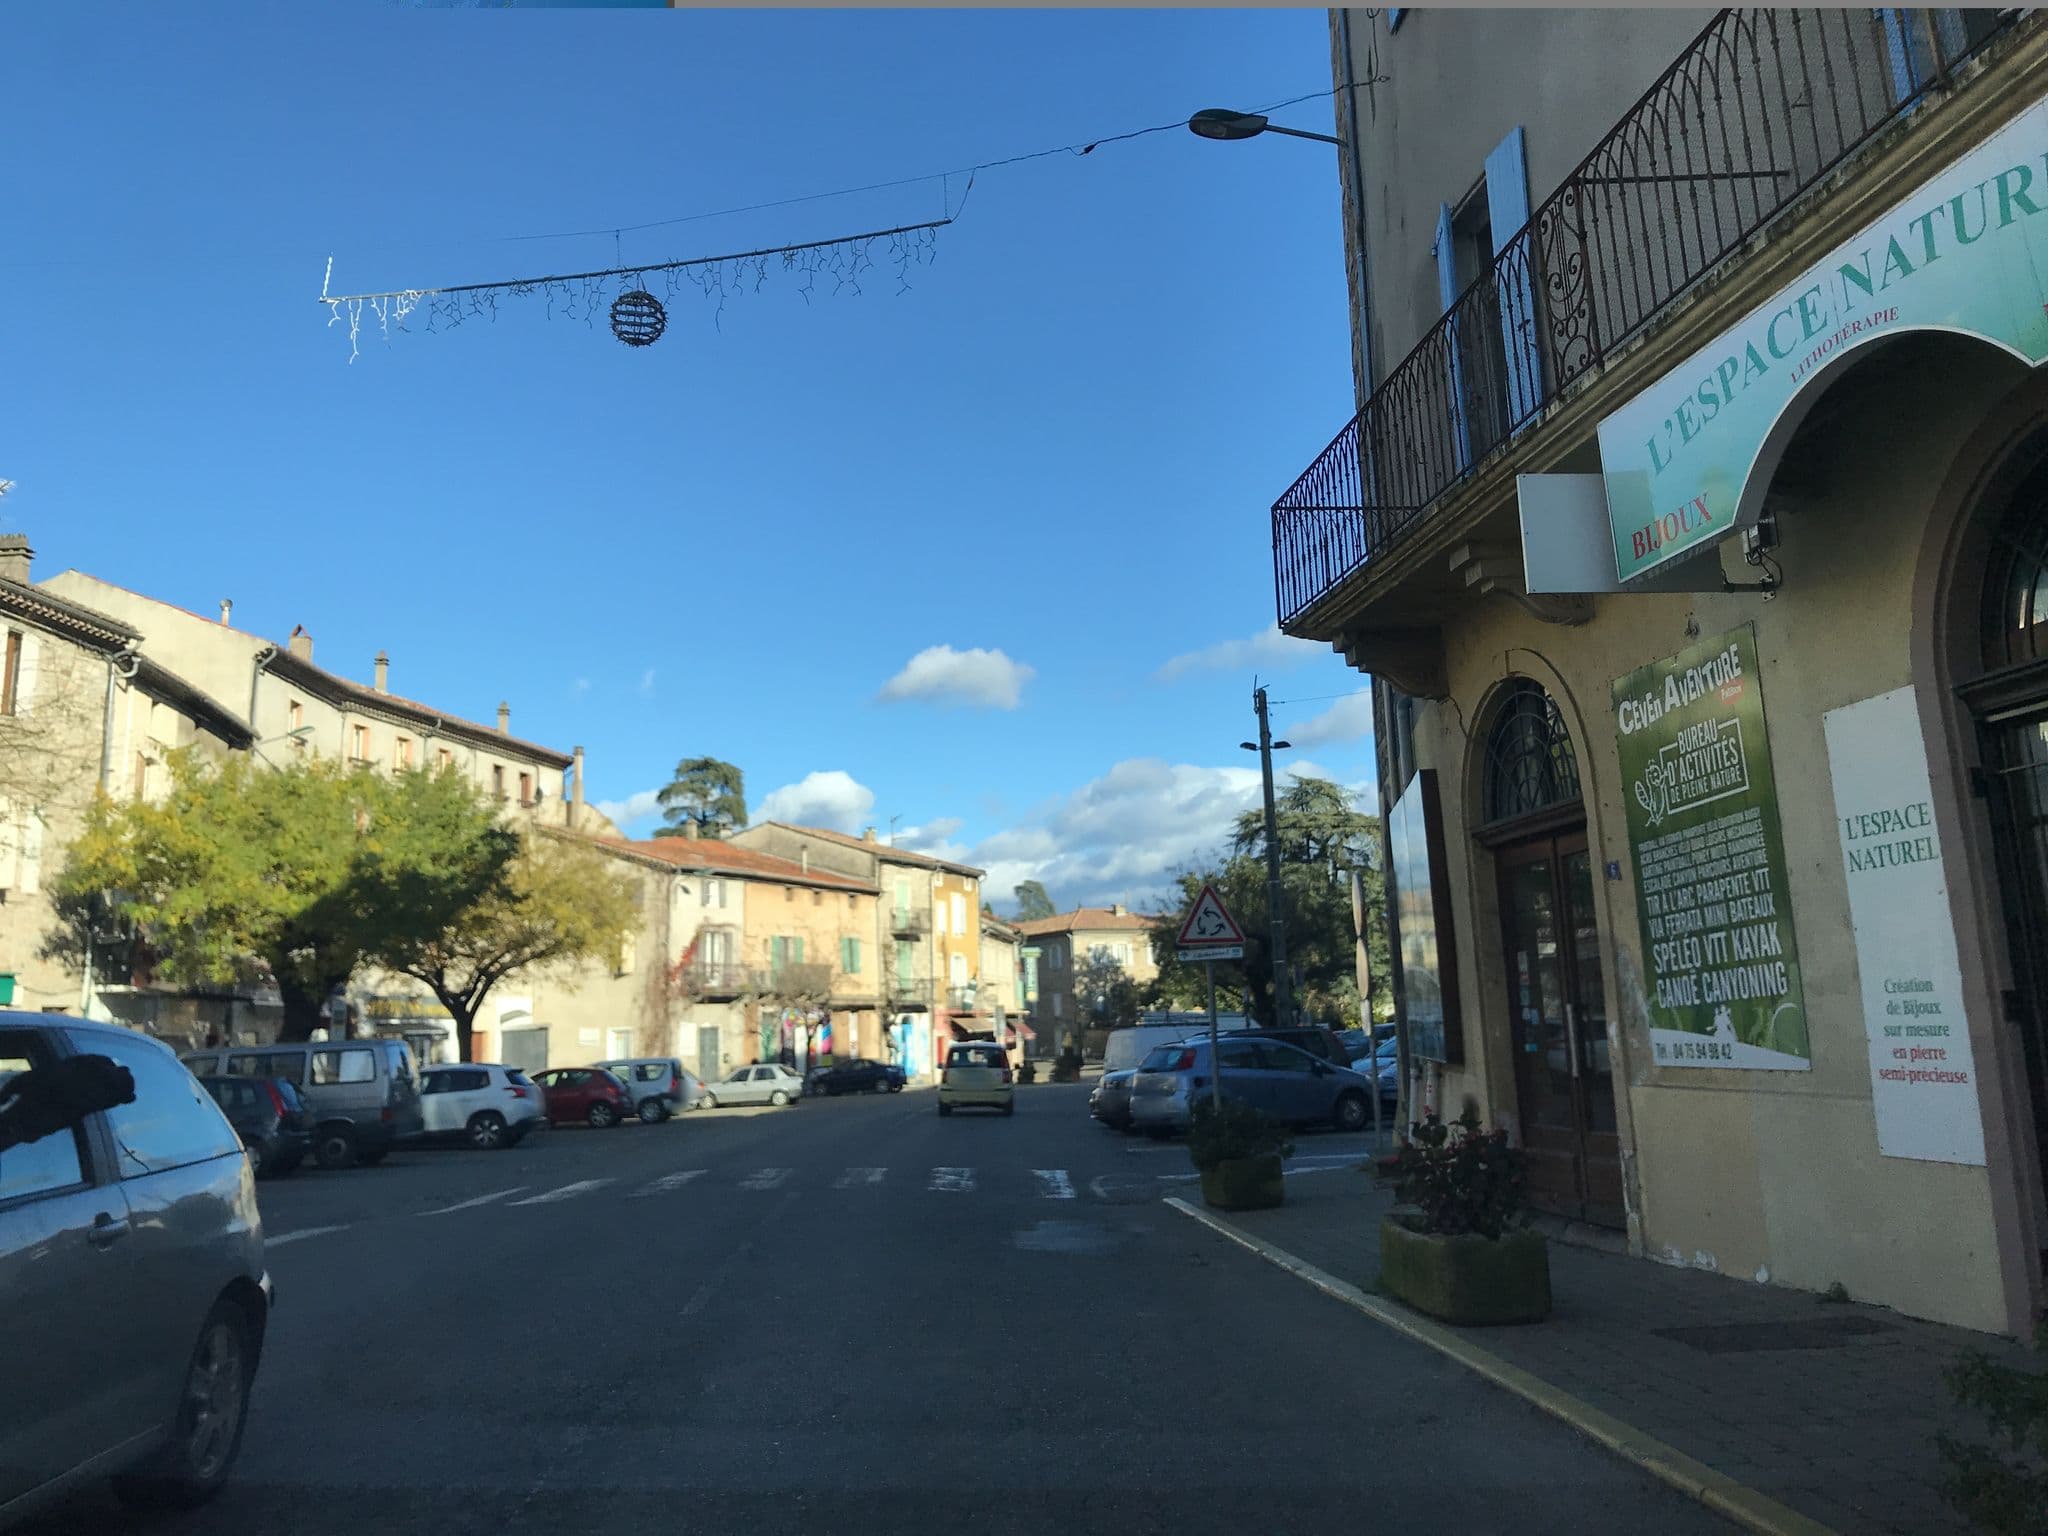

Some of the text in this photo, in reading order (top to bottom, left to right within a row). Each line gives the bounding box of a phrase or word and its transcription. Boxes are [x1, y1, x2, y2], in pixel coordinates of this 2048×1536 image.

[1645, 152, 2048, 476] L'ESPACE NATUR
[1791, 306, 1899, 383] LITHOTÉRAPIE
[1631, 492, 1713, 560] BIJOUX
[1665, 643, 1741, 713] AVENTURE
[1678, 718, 1718, 754] BUREAU
[1667, 734, 1739, 786] D'ACTIVITÉS
[1671, 765, 1742, 804] DE PLEINE NATURE
[1845, 802, 1931, 840] L'ESPACE
[1848, 836, 1939, 873] NATUREL
[1646, 895, 1661, 917] TIR
[1669, 886, 1695, 911] L'ARC
[1696, 872, 1751, 905] PARAPENTE
[1752, 868, 1770, 892] VTT
[1648, 892, 1776, 939] VIA FERRATA MINI BATEAUX
[1653, 921, 1782, 974] SPÉLÉO VTT KAYAK
[1702, 961, 1788, 1003] CANYONING
[1884, 978, 1933, 993] Création
[1887, 1000, 1941, 1018] de Bijoux
[1884, 1025, 1950, 1037] sur mesure
[1893, 1045, 1947, 1062] en pierre
